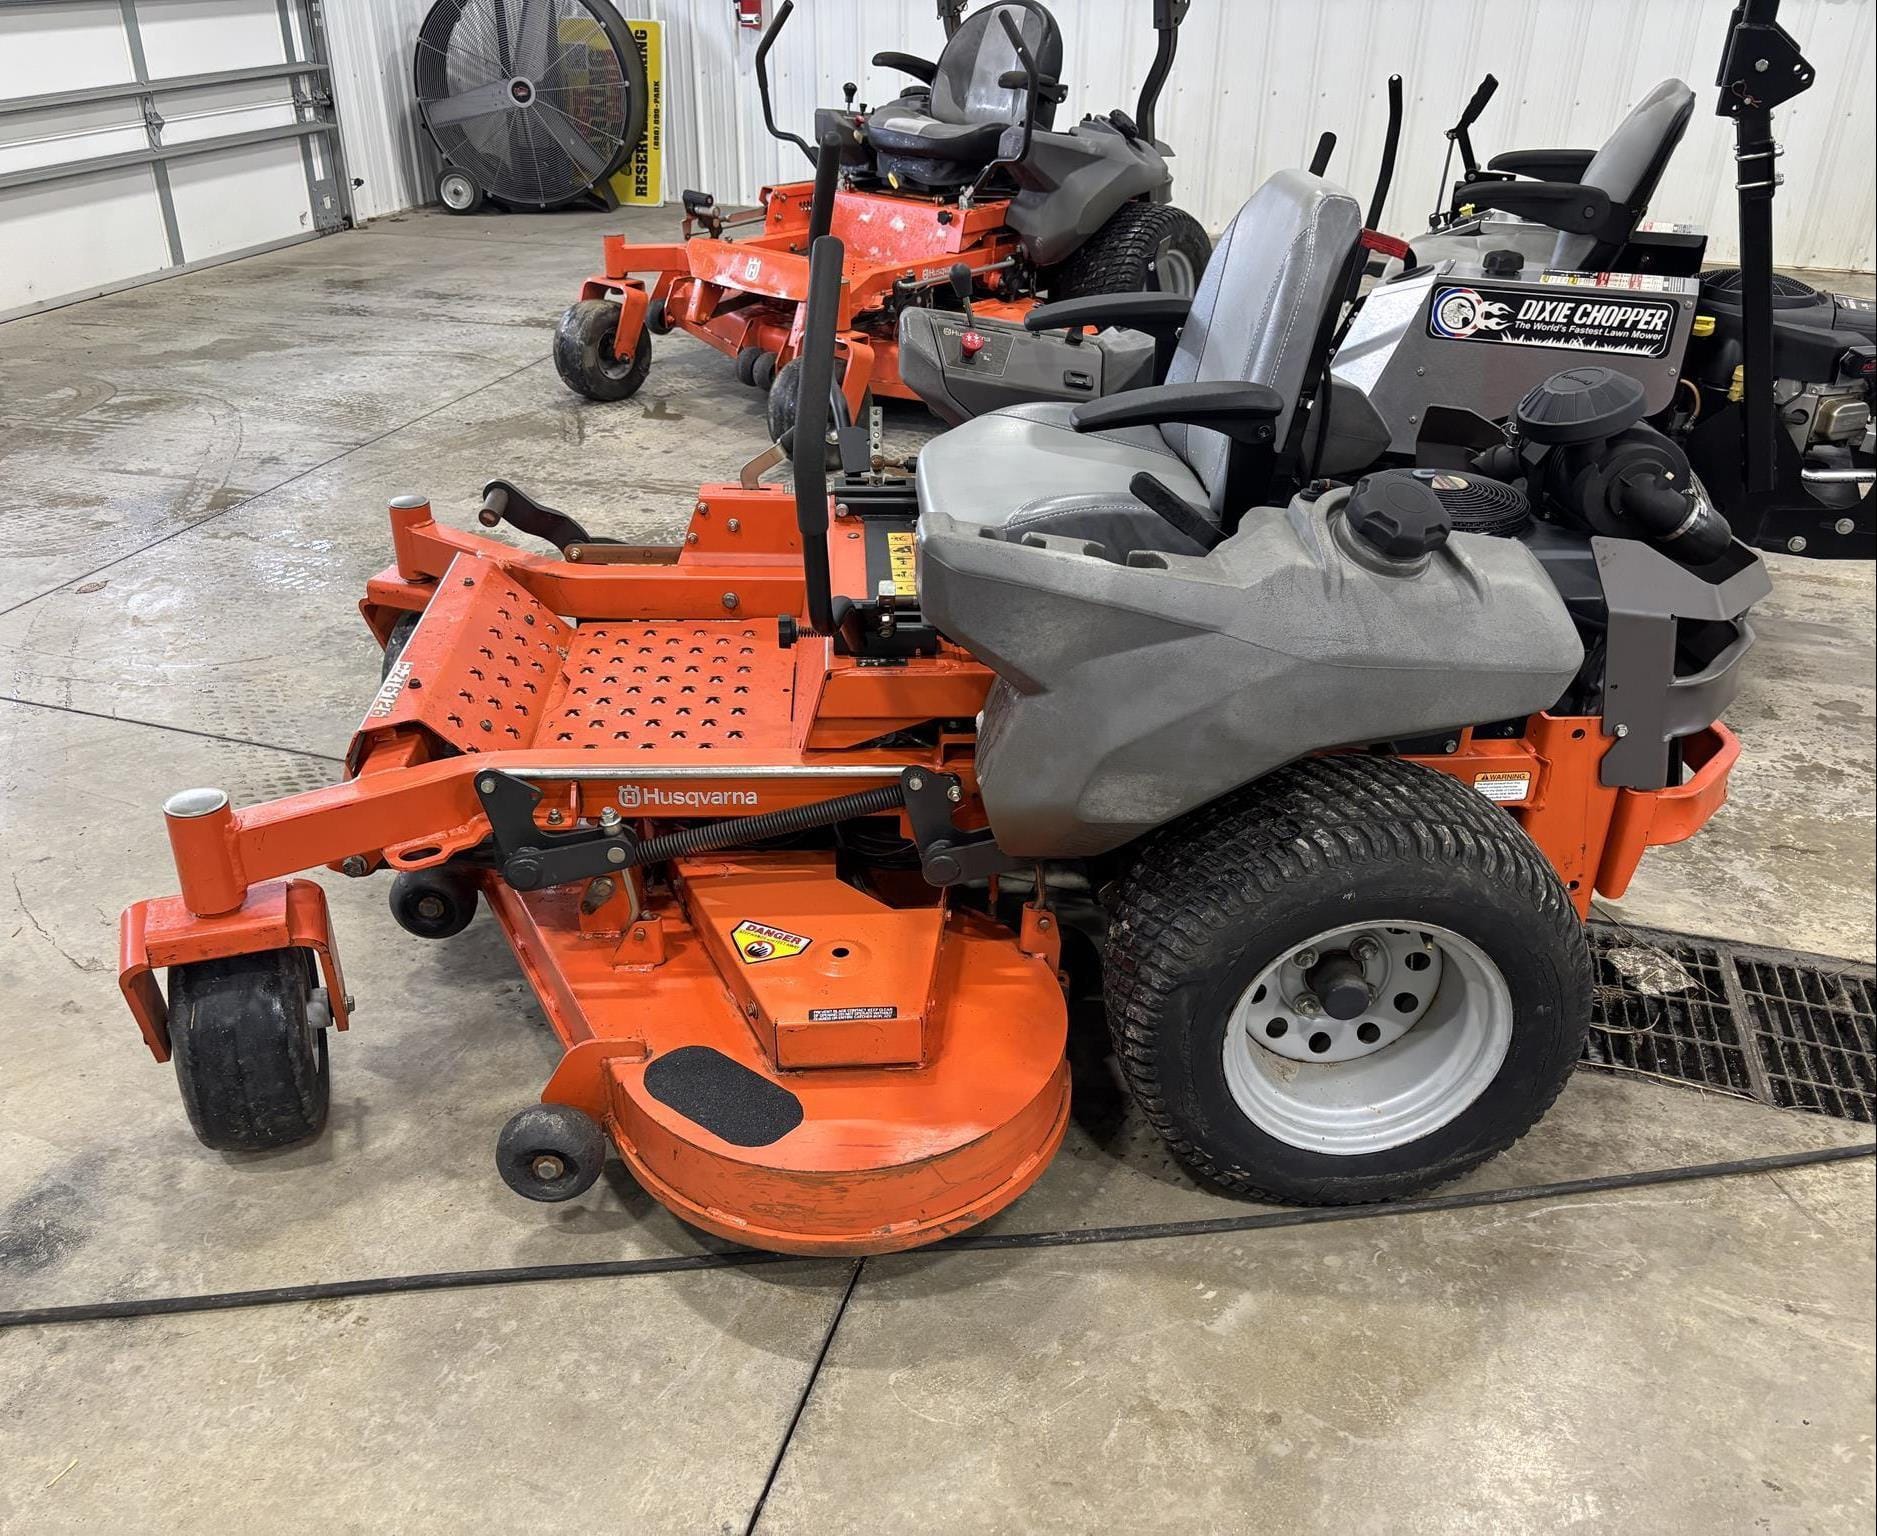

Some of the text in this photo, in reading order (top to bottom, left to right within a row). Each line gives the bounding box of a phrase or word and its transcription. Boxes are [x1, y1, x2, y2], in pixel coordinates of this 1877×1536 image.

[1518, 300, 1668, 331] DIXIE CHOPPER
[1515, 320, 1663, 341] The World's Fastest Lawn Mower
[1490, 773, 1526, 781] WARNING
[643, 788, 757, 807] Husqvarna
[745, 924, 802, 945] DANGER
